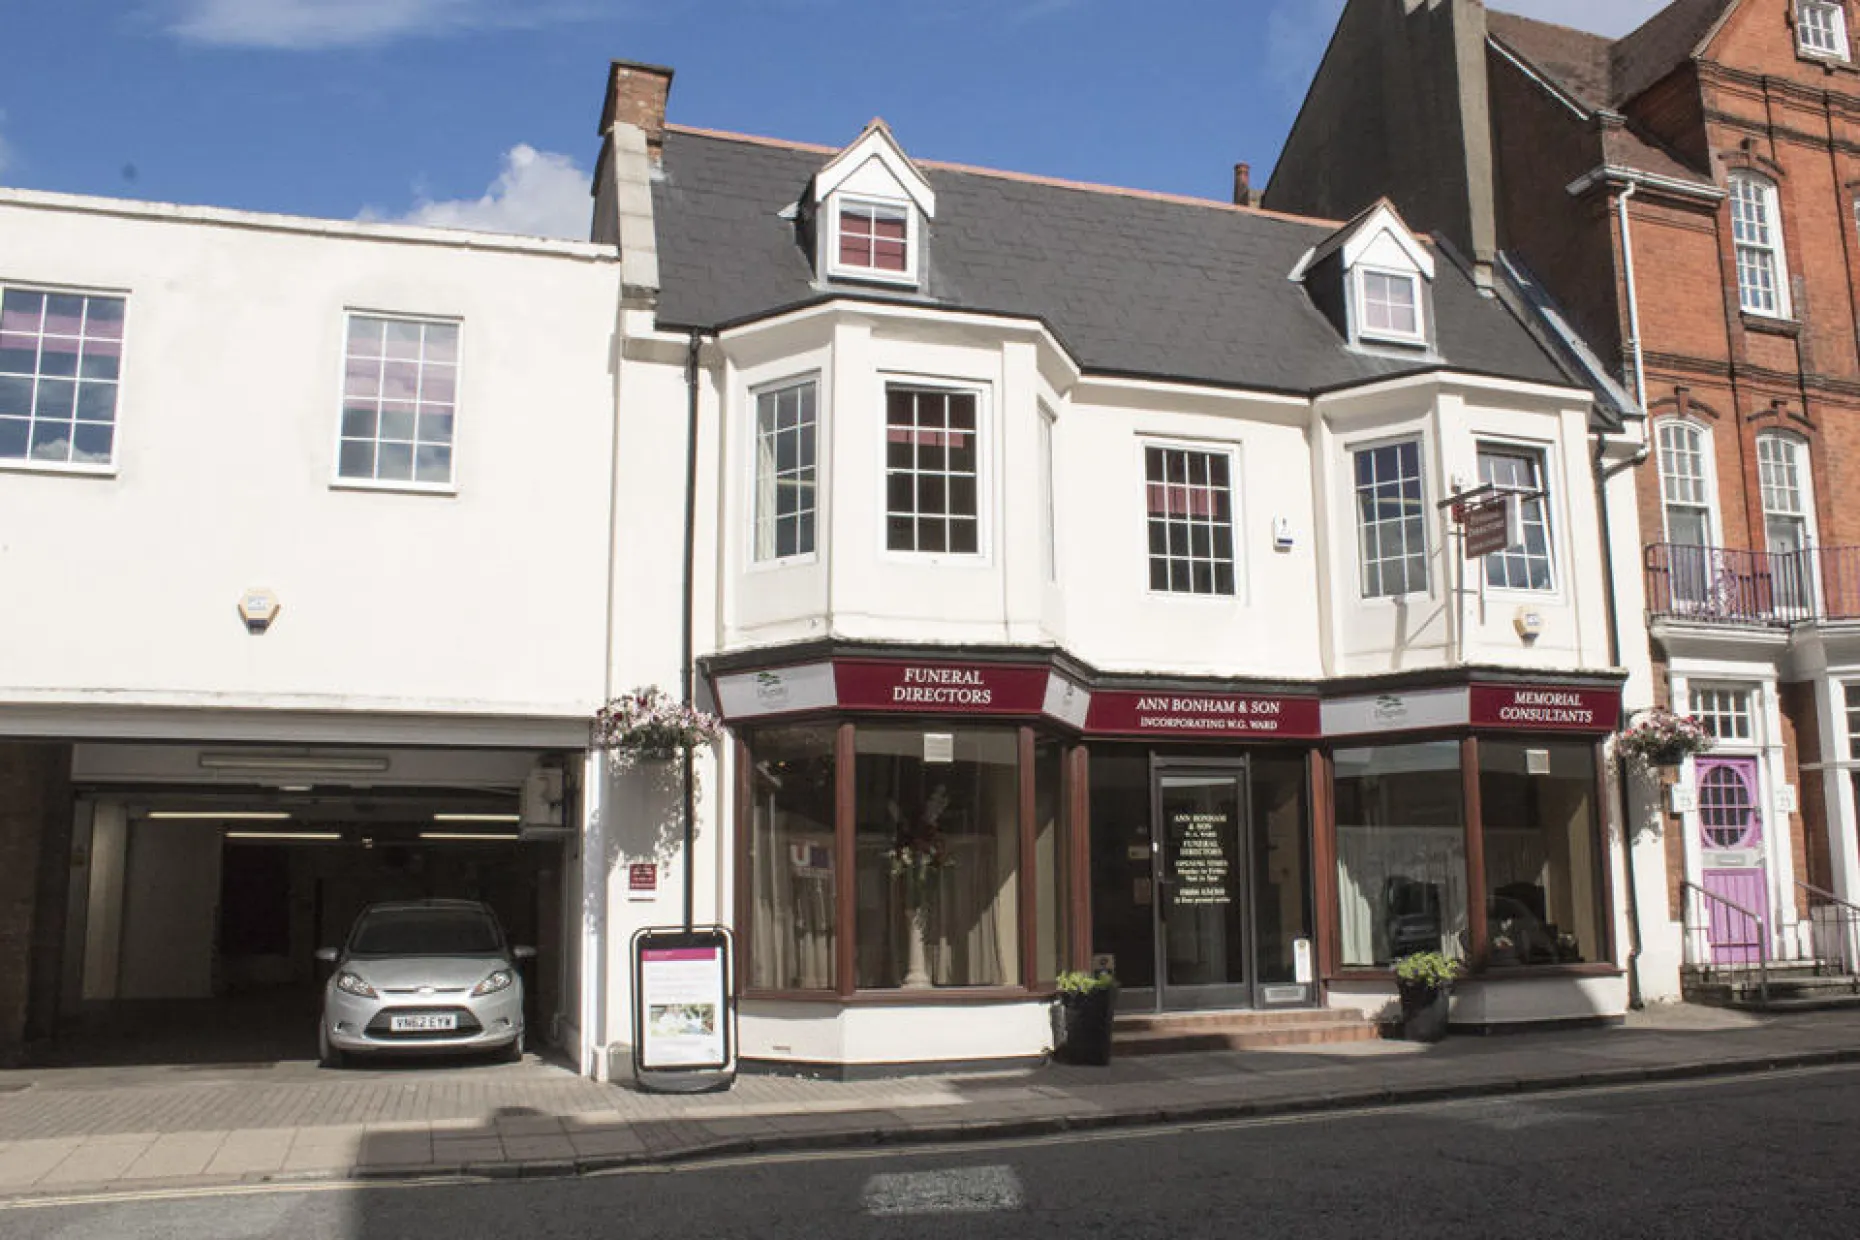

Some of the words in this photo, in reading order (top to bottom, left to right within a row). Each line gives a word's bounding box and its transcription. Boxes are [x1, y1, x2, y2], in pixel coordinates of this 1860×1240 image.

[904, 668, 984, 684] FUNERAL
[892, 686, 991, 704] DIRECTORS
[1514, 691, 1582, 706] MEMORIAL
[1135, 697, 1169, 710] ANN
[1171, 698, 1236, 713] BONHAM
[1237, 700, 1249, 713] &
[1251, 700, 1280, 714] SON
[1140, 716, 1225, 729] INCORPORATING
[1250, 720, 1278, 729] WARD
[1499, 706, 1593, 724] CONSULTANTS
